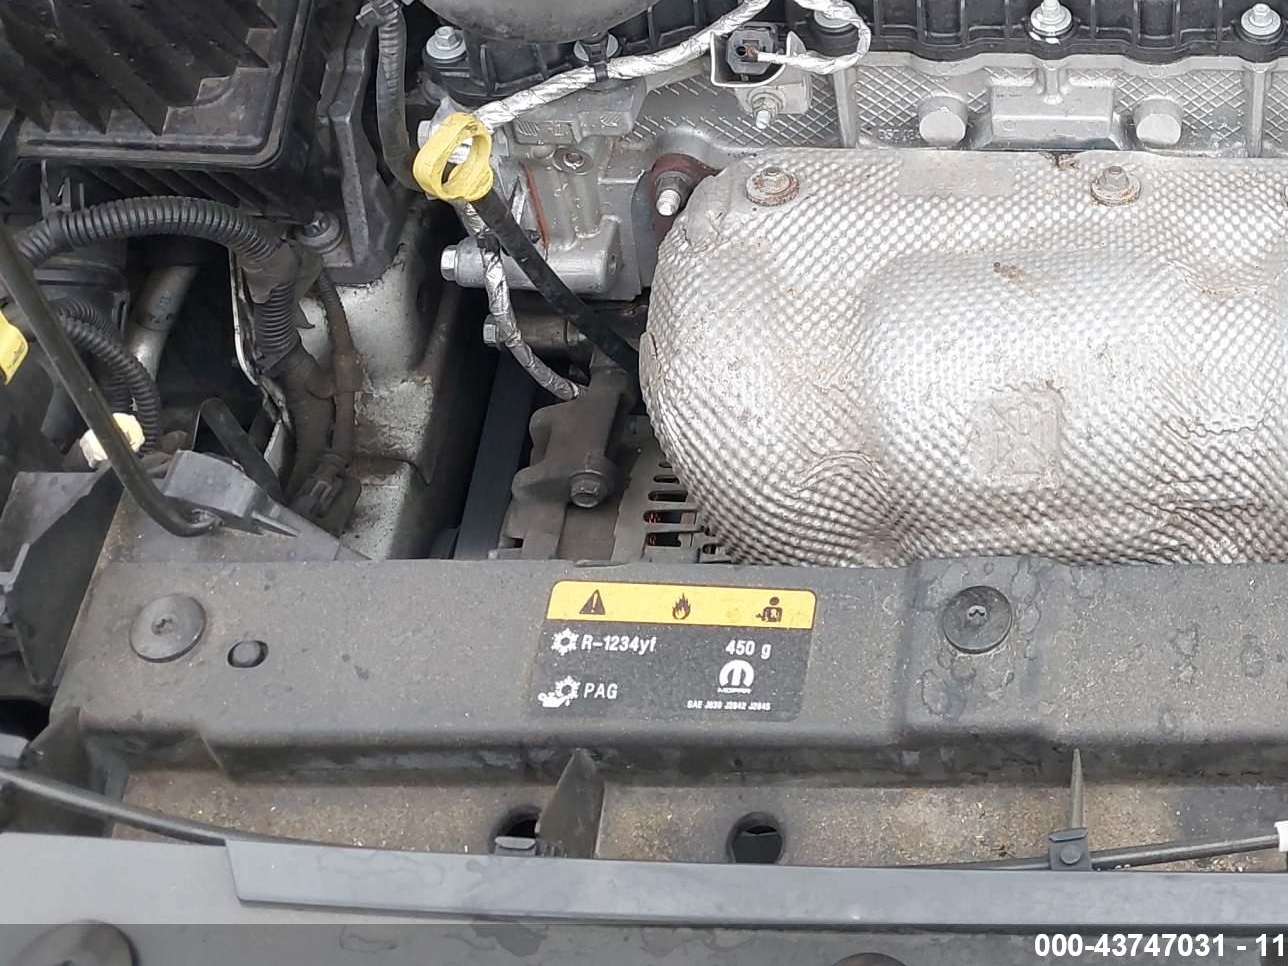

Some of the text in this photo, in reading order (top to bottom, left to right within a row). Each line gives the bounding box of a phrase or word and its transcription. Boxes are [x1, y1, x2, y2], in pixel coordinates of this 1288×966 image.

[581, 635, 771, 660] R-1234yf 450 g
[584, 683, 617, 699] PAG
